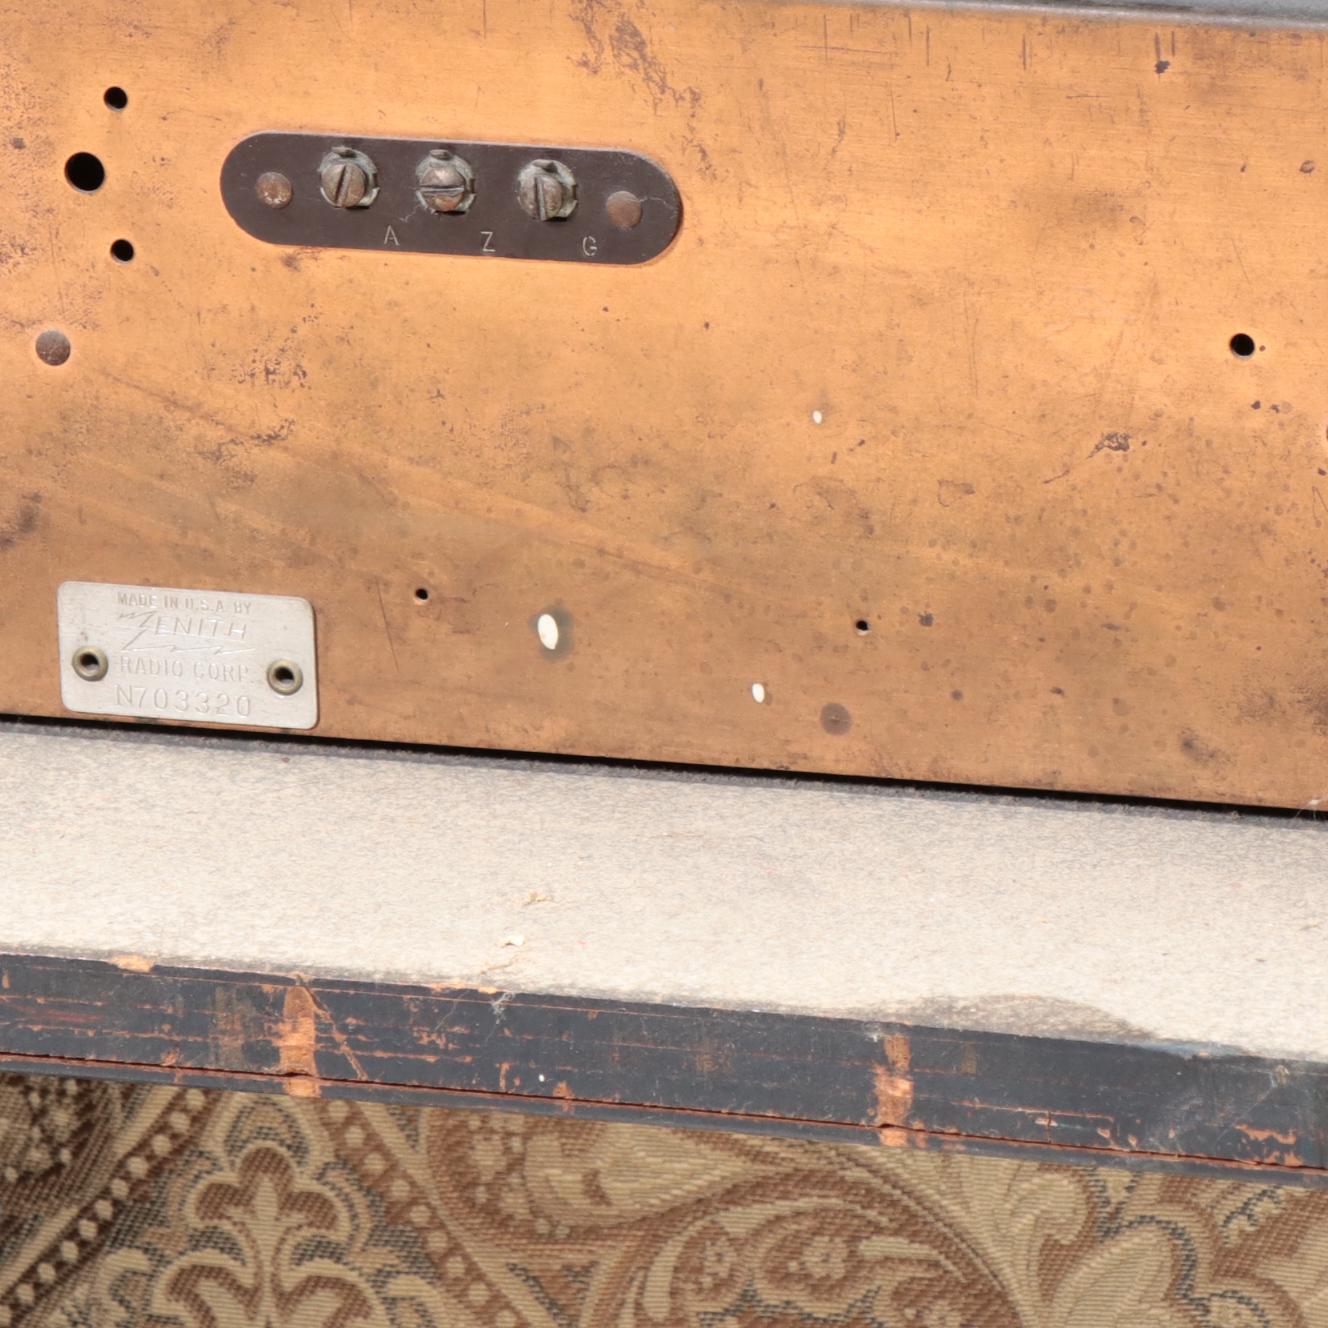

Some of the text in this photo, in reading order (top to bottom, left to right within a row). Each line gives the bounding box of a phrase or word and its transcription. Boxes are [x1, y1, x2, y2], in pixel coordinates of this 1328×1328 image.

[383, 225, 598, 257] A Z G
[117, 591, 157, 608] MADE
[164, 594, 178, 609] IN
[233, 600, 252, 615] BY
[118, 610, 254, 655] ZENITH
[120, 655, 184, 677] RADIO
[115, 683, 251, 717] N703320
